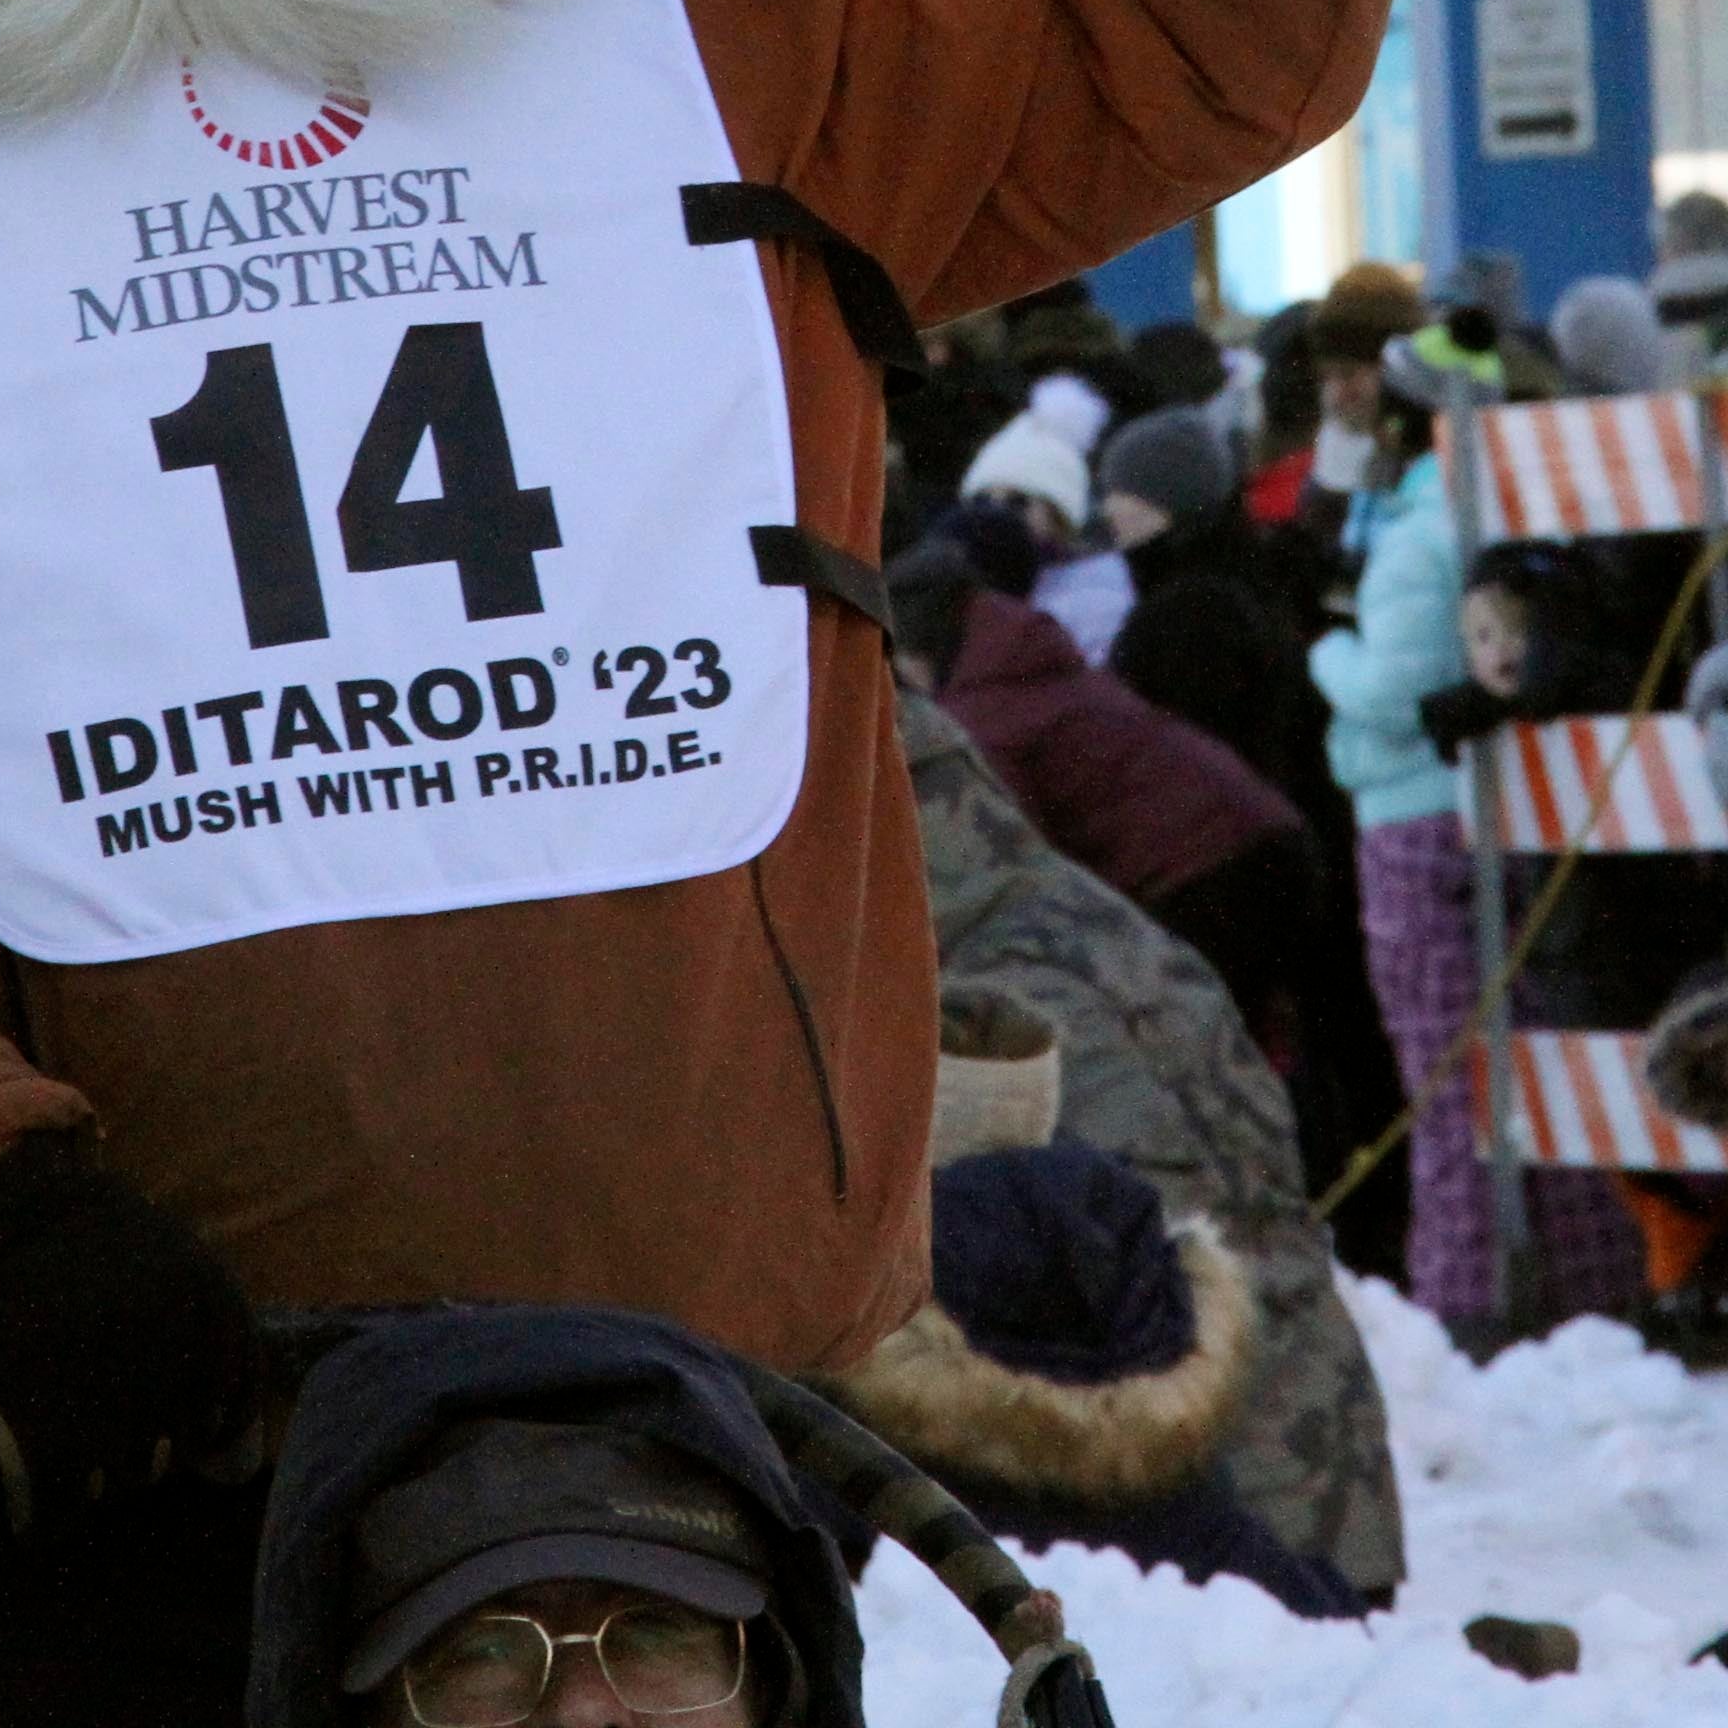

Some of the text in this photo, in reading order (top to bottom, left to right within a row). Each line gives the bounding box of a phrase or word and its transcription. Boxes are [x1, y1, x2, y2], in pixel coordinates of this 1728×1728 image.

[125, 167, 470, 263] HARVEST
[69, 231, 547, 342] MIDSTREAM
[148, 320, 564, 651] 14
[94, 729, 724, 858] MUSH WITH P.R.I.D.E.
